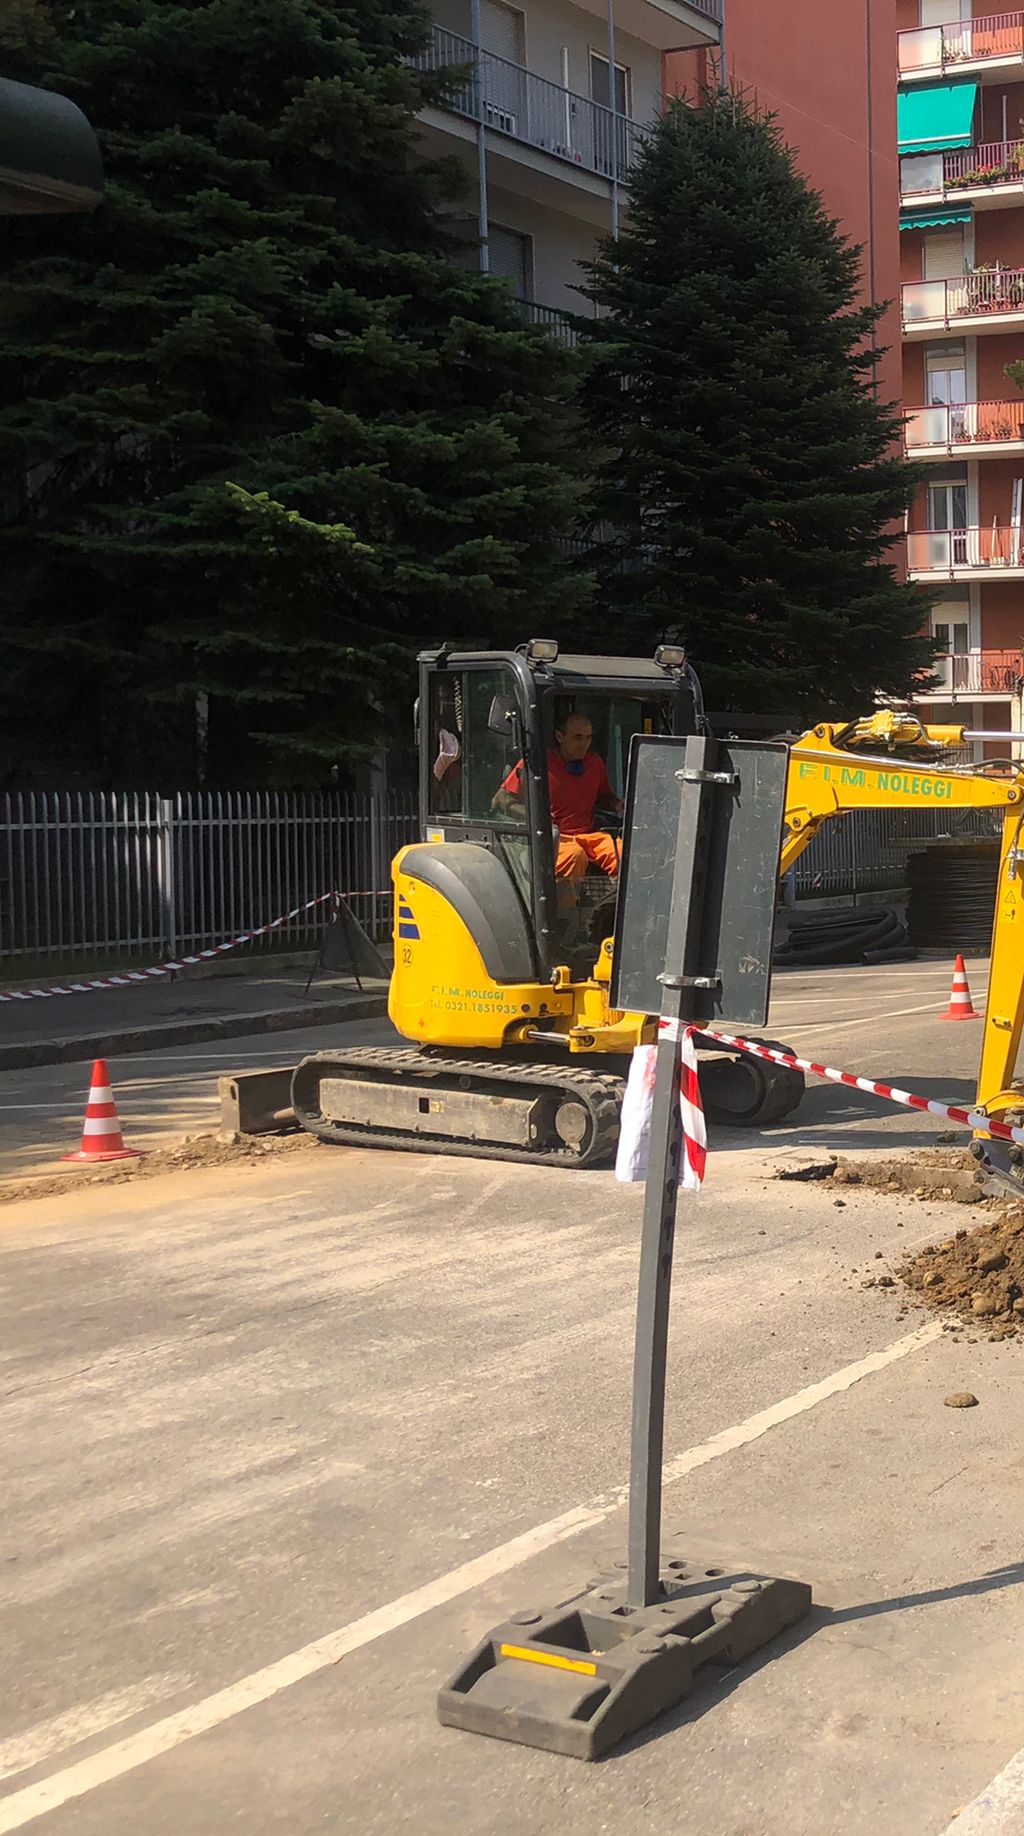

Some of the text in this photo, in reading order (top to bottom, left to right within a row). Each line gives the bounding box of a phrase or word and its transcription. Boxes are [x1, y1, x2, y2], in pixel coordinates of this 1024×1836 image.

[877, 773, 953, 799] NOLEGGI
[403, 948, 412, 964] 32
[465, 989, 505, 1001] NOLEGGI
[445, 1001, 518, 1014] 0321.1851935
